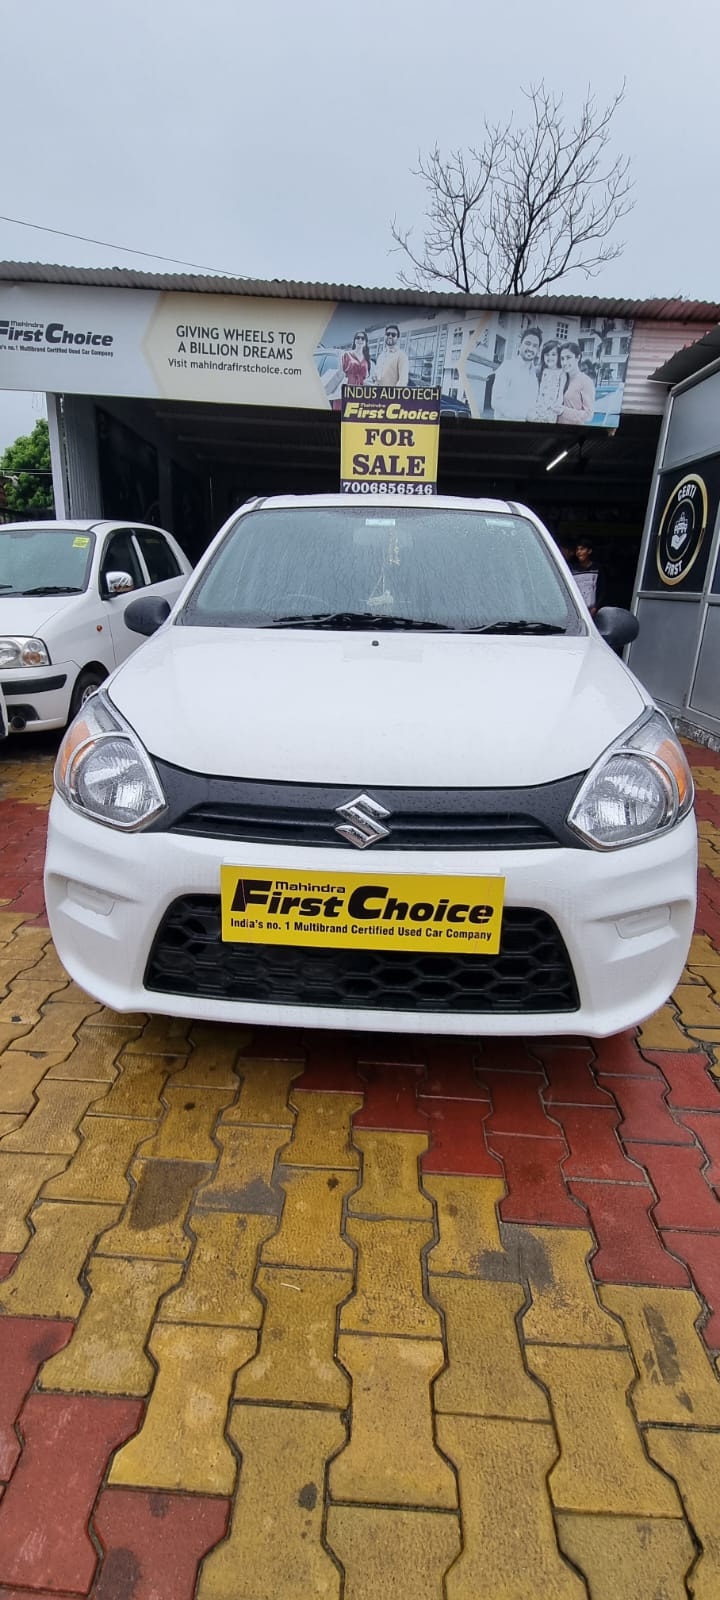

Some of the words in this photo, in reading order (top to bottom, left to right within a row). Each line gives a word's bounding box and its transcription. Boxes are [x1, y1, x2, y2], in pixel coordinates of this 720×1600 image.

[11, 320, 44, 328] Mahindra
[45, 323, 114, 346] Choice
[176, 325, 219, 340] GIVING
[223, 328, 274, 344] WHEELS
[278, 331, 296, 345] TO
[91, 349, 114, 357] Company
[178, 341, 186, 353] A
[190, 342, 239, 357] BILLION
[243, 345, 293, 360] DREAMS
[168, 358, 187, 368] Visit
[190, 359, 302, 376] mahindrafirstchoice.com
[344, 386, 377, 399] INDUS
[380, 387, 439, 401] AUTOTECH
[344, 402, 385, 419] First
[386, 403, 438, 420] Choice
[364, 428, 415, 447] FOR
[353, 454, 426, 476] SALE
[343, 482, 432, 495] 7006856546
[664, 559, 683, 576] FIRST
[275, 881, 345, 894] Mahindra
[230, 878, 344, 917] First
[347, 885, 494, 924] Choice
[230, 918, 264, 929] India's
[266, 920, 282, 930] no.
[285, 921, 290, 930] 1
[294, 922, 348, 934] Multibrand
[351, 924, 394, 936] Certified
[398, 926, 422, 937] Used
[425, 928, 443, 938] Car
[446, 929, 492, 942] Company
